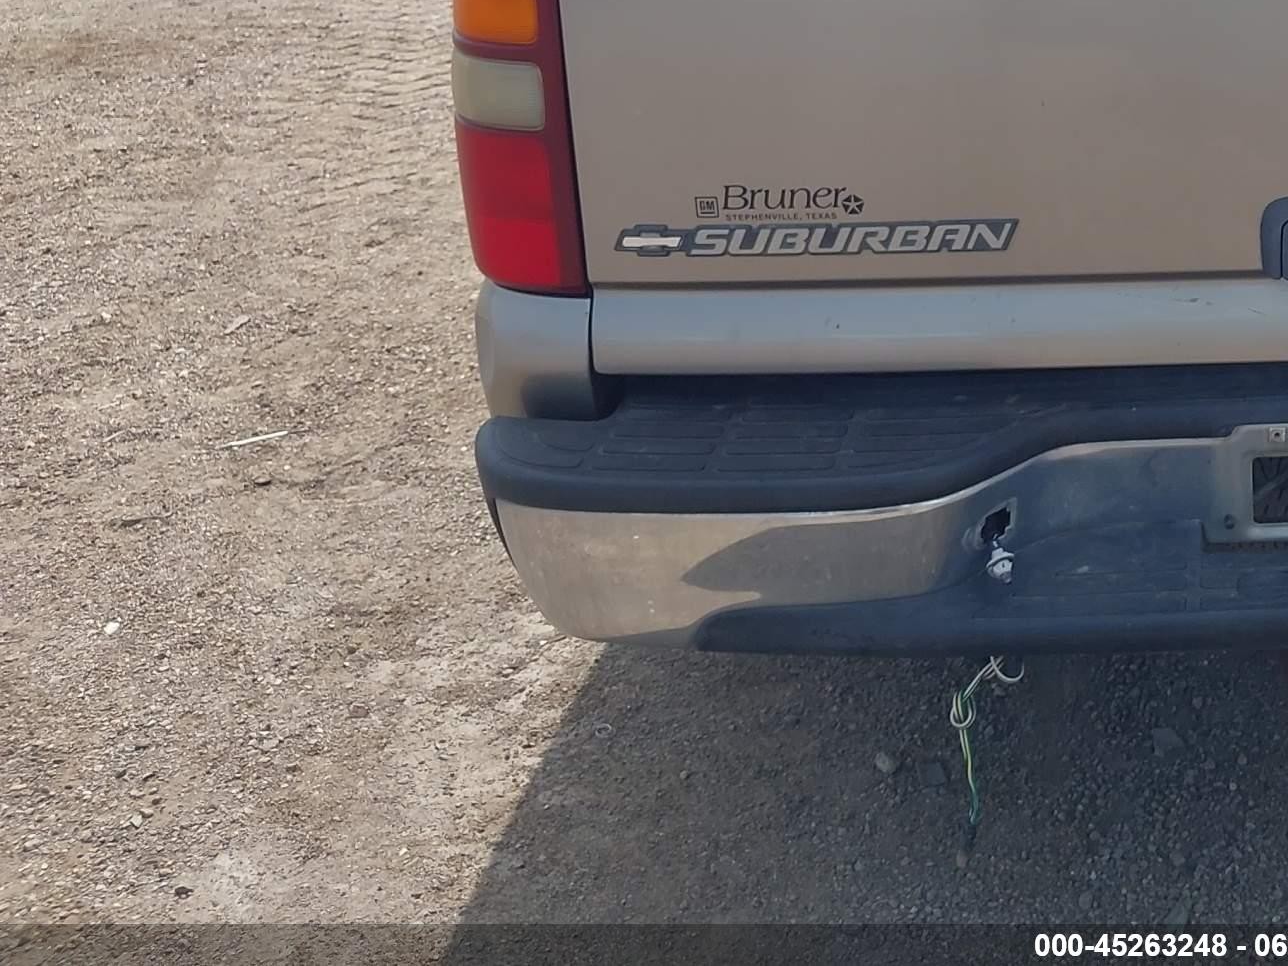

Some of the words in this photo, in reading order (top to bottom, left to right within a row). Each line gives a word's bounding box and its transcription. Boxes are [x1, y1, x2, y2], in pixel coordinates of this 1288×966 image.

[722, 184, 847, 211] Bruner
[725, 213, 802, 222] STEPHENVILLE,
[806, 212, 838, 220] TEXAS
[689, 221, 1014, 256] SUBURBAN
